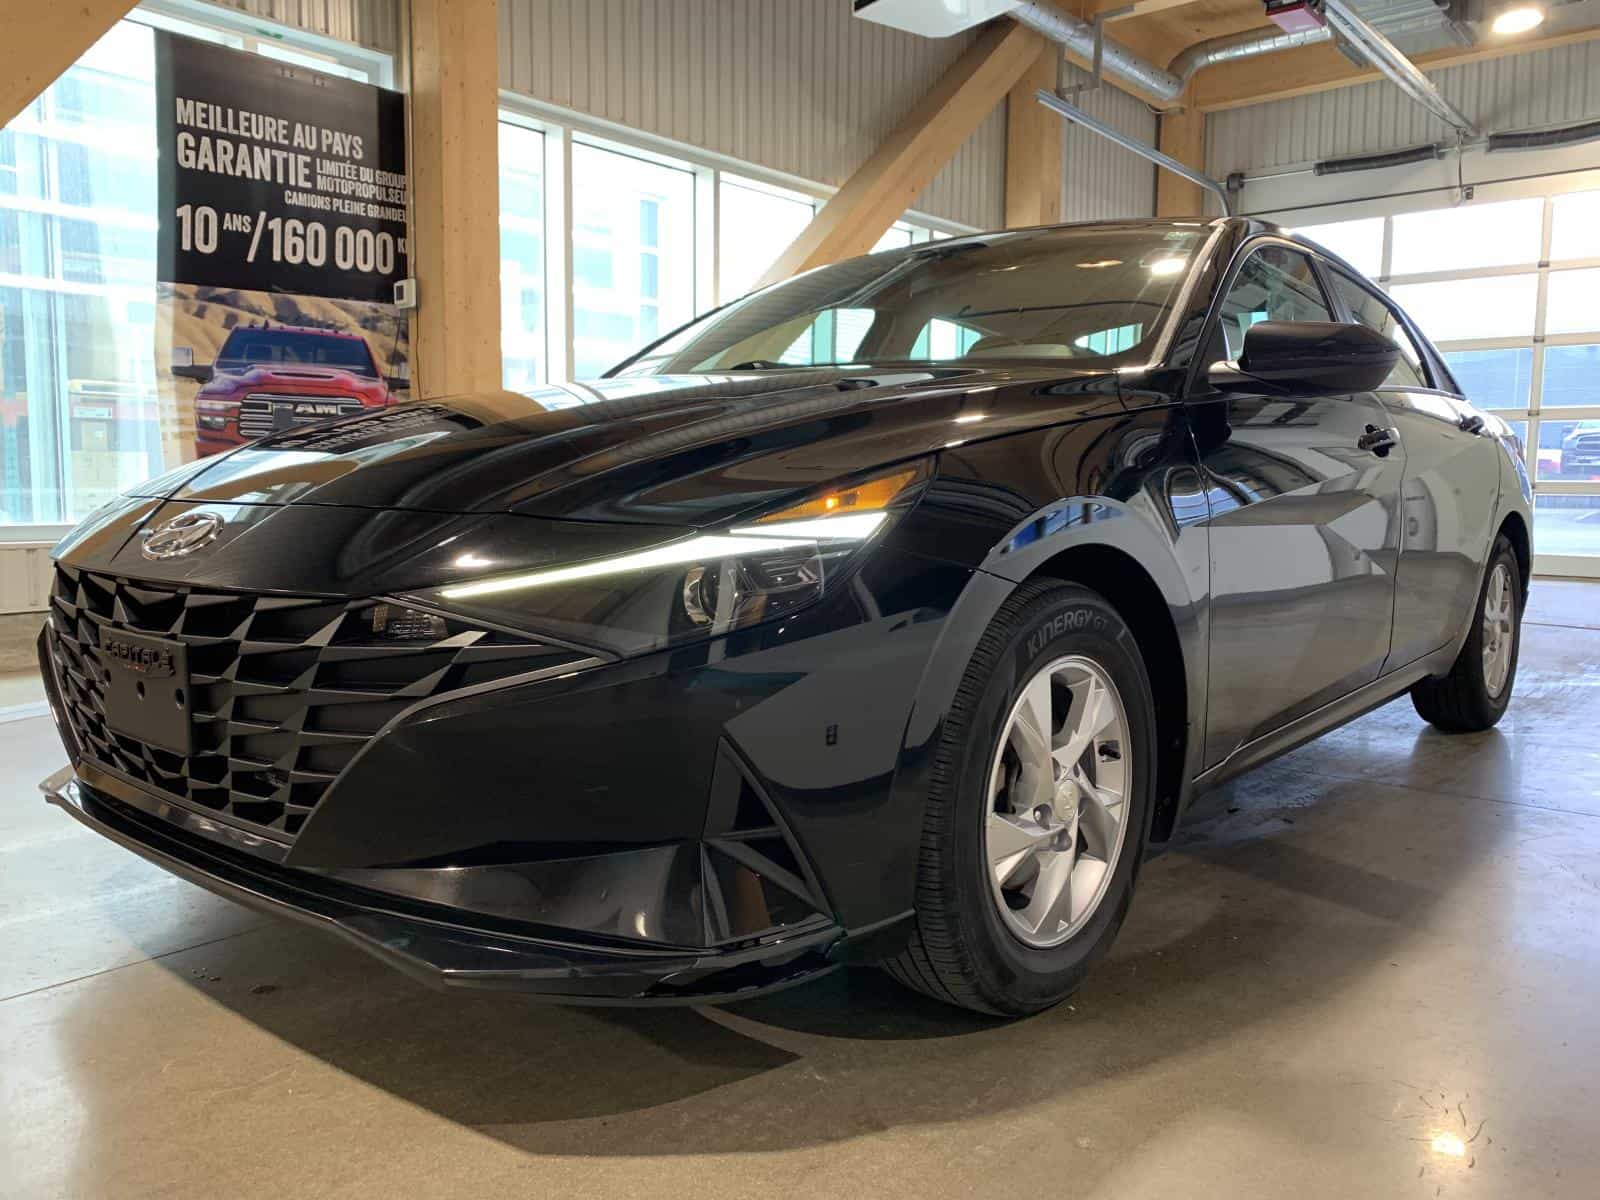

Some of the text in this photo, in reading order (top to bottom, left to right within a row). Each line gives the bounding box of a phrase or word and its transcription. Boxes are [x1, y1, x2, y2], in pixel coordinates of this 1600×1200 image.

[175, 97, 363, 160] MEILLEURE AU PAYS
[176, 132, 313, 189] GARANTIE
[316, 158, 358, 181] LIMITÉE
[359, 166, 374, 184] DU
[284, 190, 331, 211] CAMIONS
[332, 197, 366, 217] PLEINE
[176, 204, 218, 254] 10
[335, 226, 395, 275] 000
